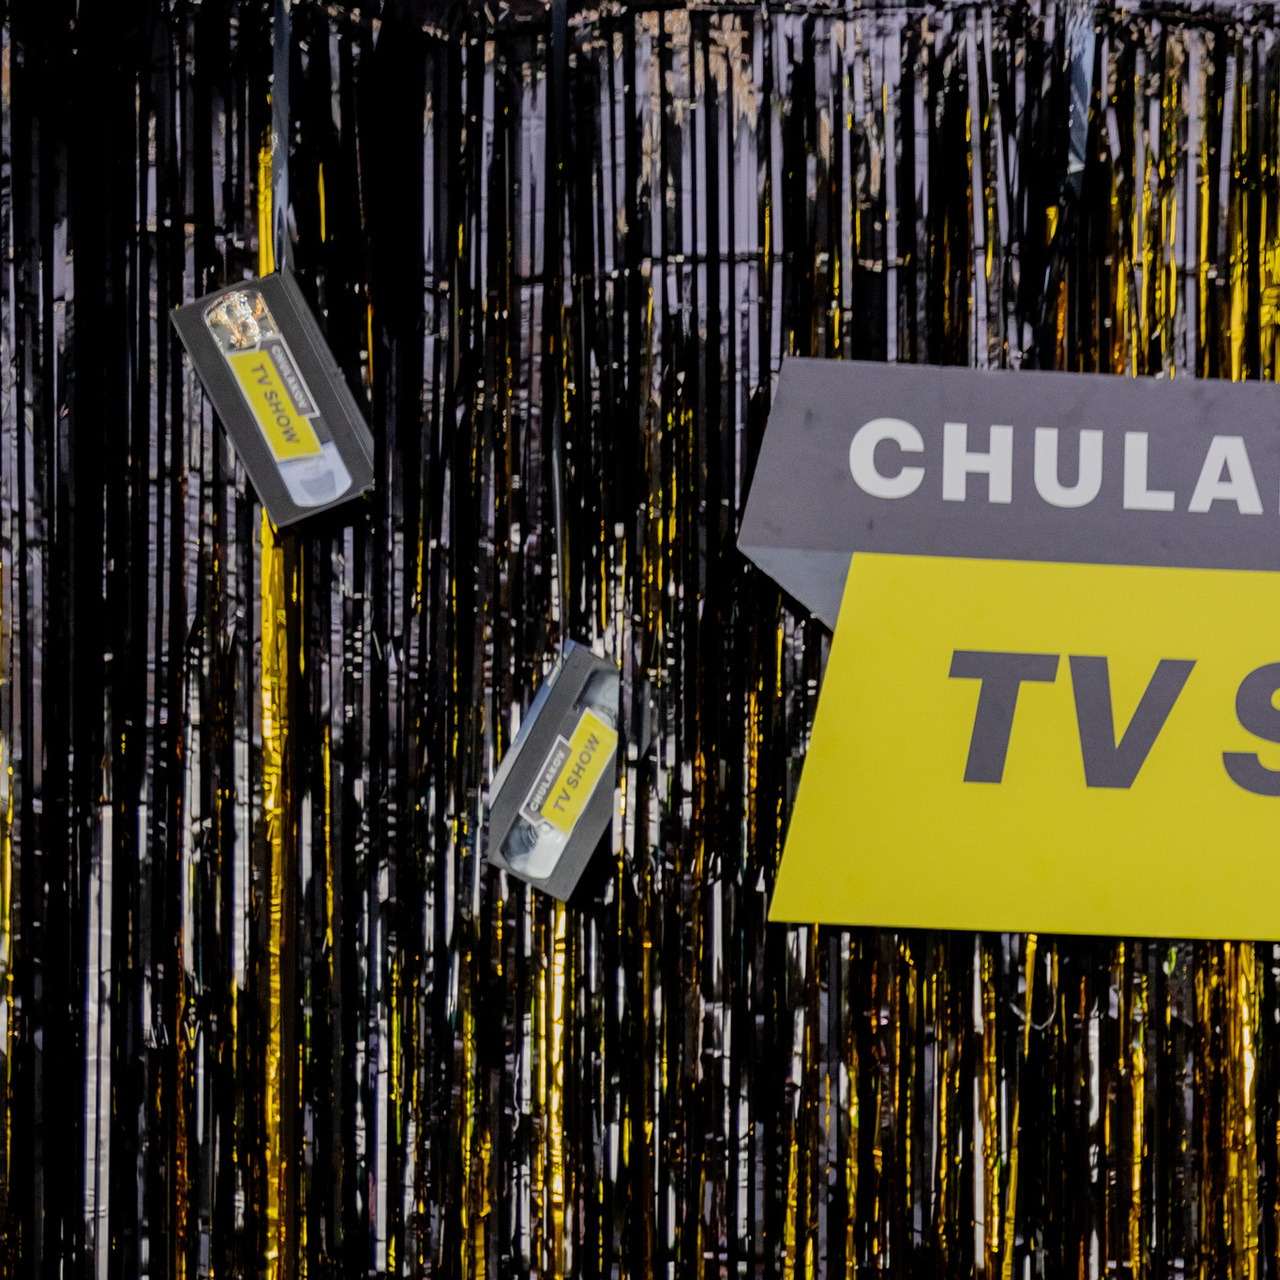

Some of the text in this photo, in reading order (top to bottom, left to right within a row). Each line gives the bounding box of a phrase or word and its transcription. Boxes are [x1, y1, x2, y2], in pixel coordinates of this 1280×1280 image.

[251, 364, 300, 444] TV SHOW
[271, 344, 308, 409] CHULAKOV
[947, 649, 1197, 790] TV
[530, 750, 566, 812] CHULAKOV
[553, 733, 600, 813] TV SHOW
